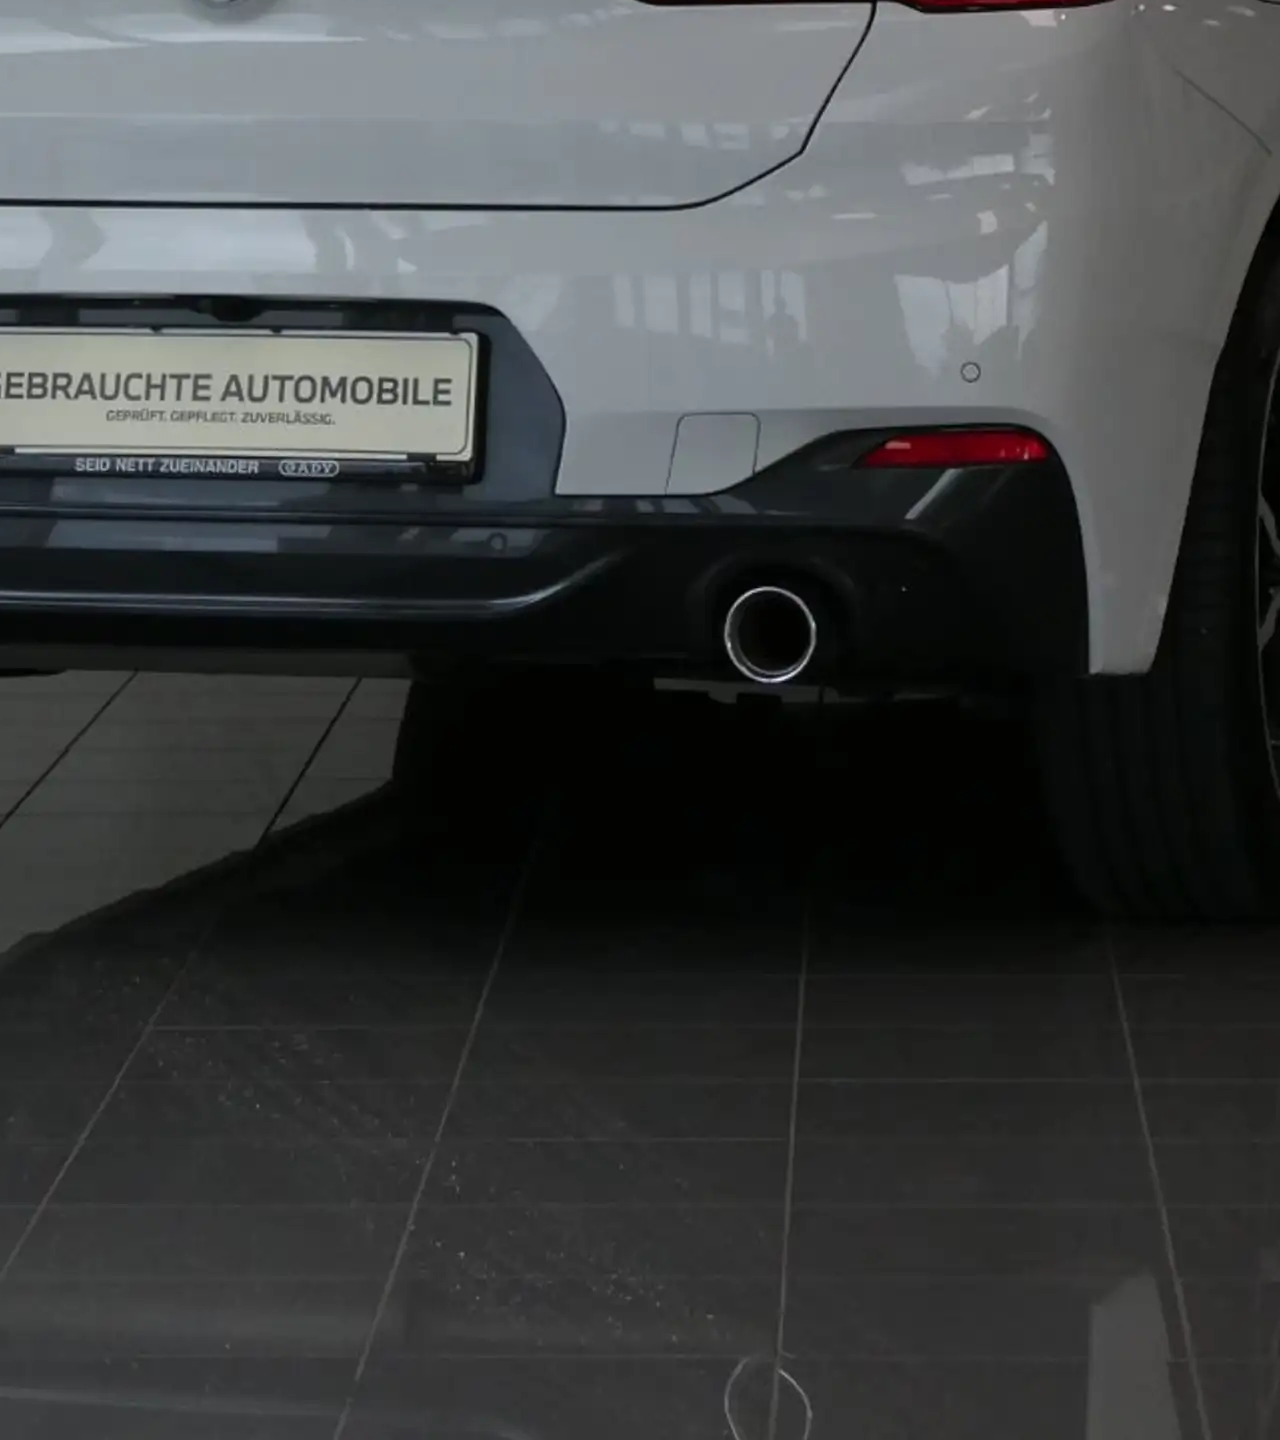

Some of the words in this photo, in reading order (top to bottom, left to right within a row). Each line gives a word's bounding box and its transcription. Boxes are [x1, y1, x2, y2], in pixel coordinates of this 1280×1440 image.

[219, 374, 453, 407] AUTOMOBILE
[74, 457, 110, 472] SEID
[115, 458, 156, 473] NETT
[159, 460, 260, 475] ZUEINANDER
